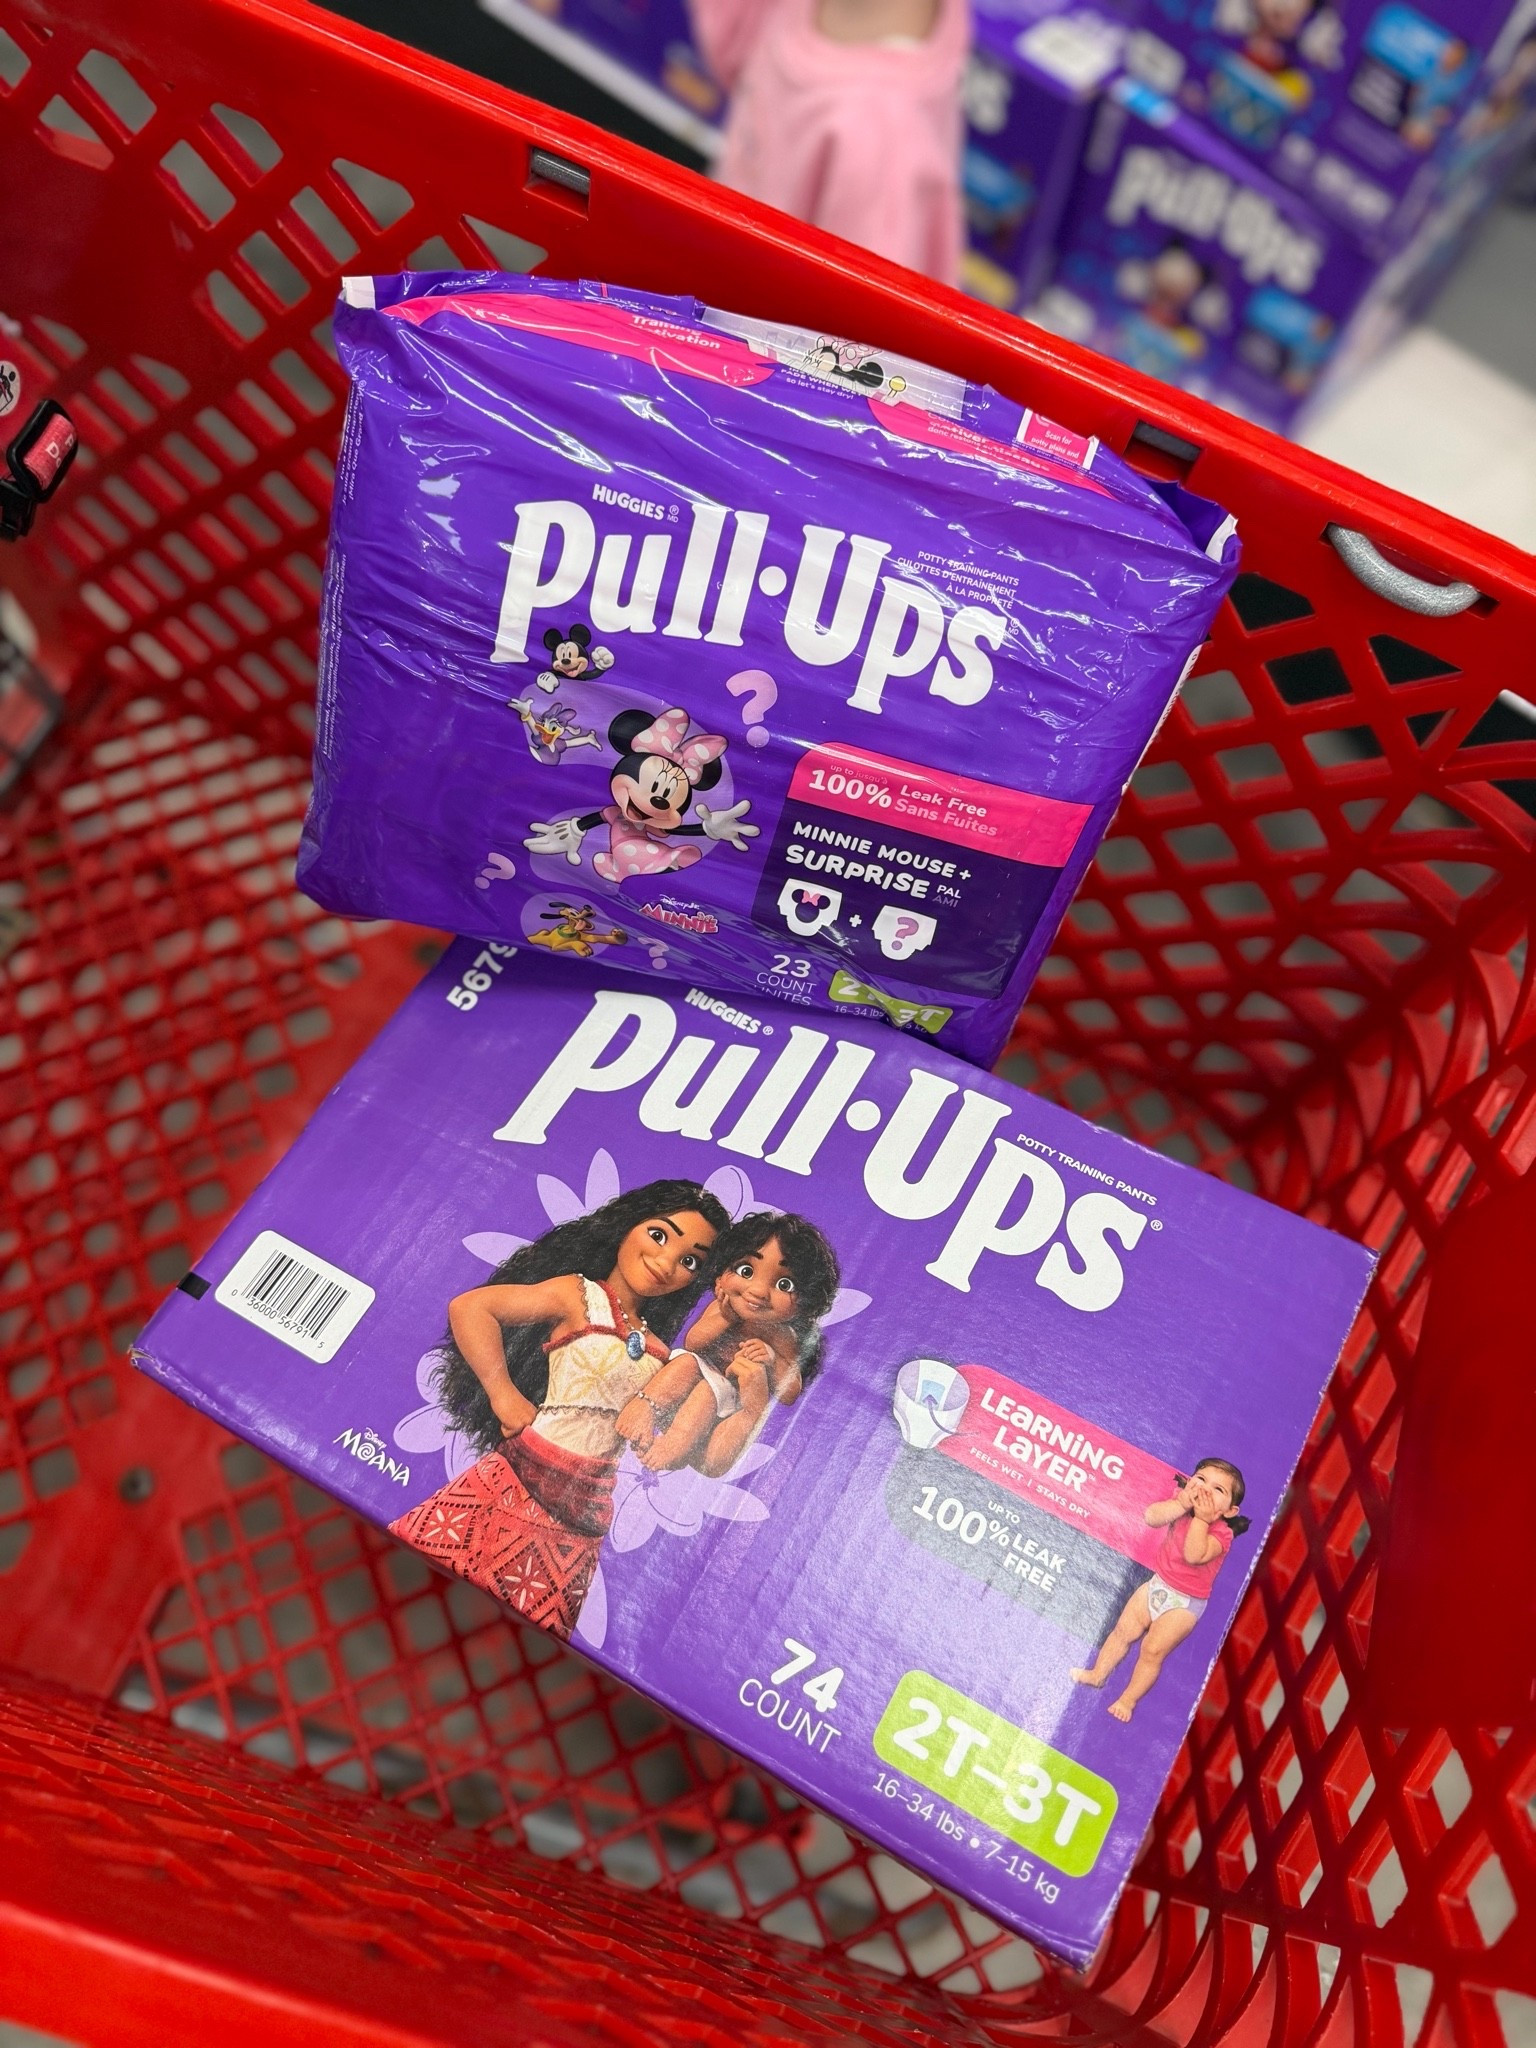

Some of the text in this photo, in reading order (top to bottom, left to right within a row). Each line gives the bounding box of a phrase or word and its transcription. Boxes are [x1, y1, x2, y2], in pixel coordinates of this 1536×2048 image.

[797, 379, 816, 390] let's
[817, 385, 836, 396] stay
[928, 426, 949, 438] donc
[1031, 436, 1081, 460] potty plans and
[1044, 430, 1073, 447] Scan for
[351, 449, 359, 471] Que
[592, 483, 666, 520] HUGGIES
[897, 557, 941, 577] CULOTTES
[918, 551, 1020, 587] POTTY TRAINING PANTS
[954, 586, 967, 597] LA
[830, 765, 843, 773] up
[844, 767, 854, 775] to
[808, 769, 892, 808] 100%
[900, 785, 988, 818] Leak Free
[894, 799, 998, 837] Sans Fuites
[793, 821, 873, 855] MINNIE
[877, 845, 957, 879] MOUSE
[785, 844, 931, 899] SURPRISE
[931, 894, 960, 908] AMI
[936, 884, 963, 899] PAL
[756, 972, 817, 994] COUNT
[770, 954, 811, 978] 23
[684, 988, 761, 1034] HUGGIES
[754, 984, 813, 1006] NITÉS
[1017, 1133, 1158, 1206] POTTY TRAINING PANTS
[247, 1296, 278, 1320] 36000
[277, 1315, 309, 1339] 56791
[317, 1341, 325, 1349] 5
[332, 1427, 411, 1488] MOANA
[970, 1447, 1091, 1519] FEELS WET STAYS DRY
[912, 1486, 1067, 1574] 100% LEAK
[987, 1501, 1021, 1524] UP TO
[1003, 1552, 1056, 1592] FREE
[771, 1638, 844, 1713] 74
[739, 1678, 842, 1754] COUNT
[936, 1810, 966, 1842] lbs
[1034, 1871, 1061, 1904] kg
